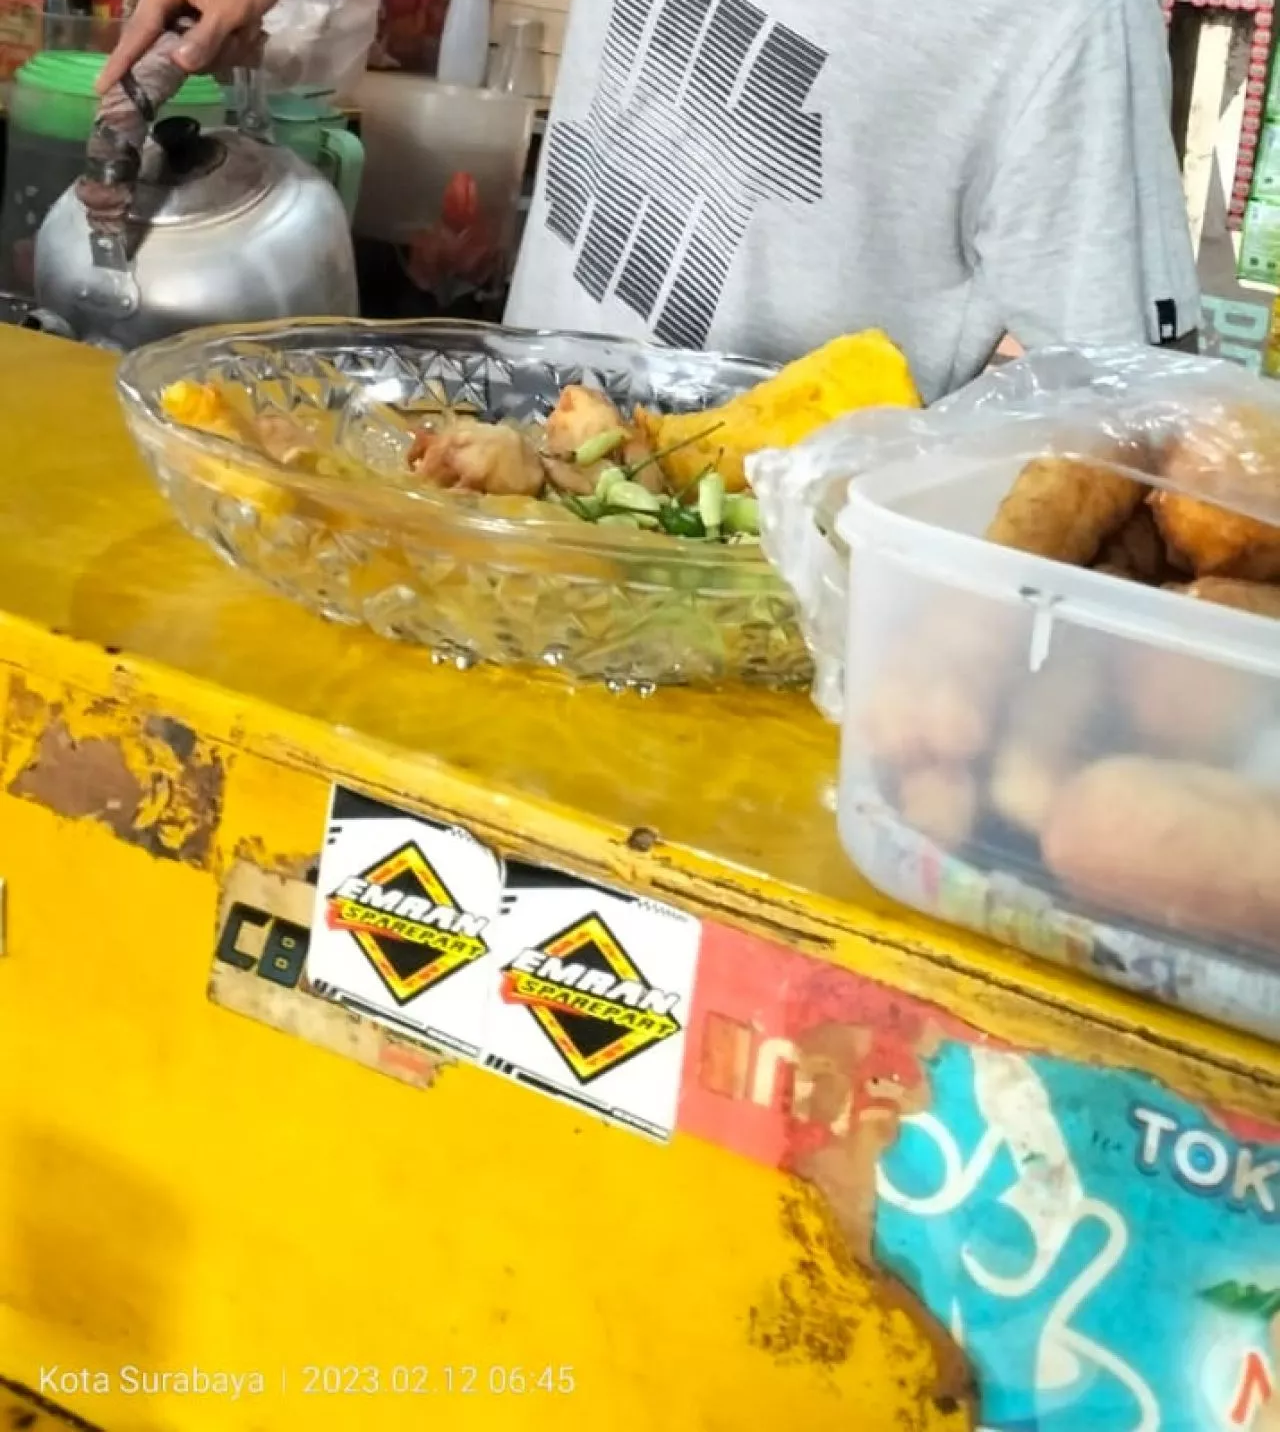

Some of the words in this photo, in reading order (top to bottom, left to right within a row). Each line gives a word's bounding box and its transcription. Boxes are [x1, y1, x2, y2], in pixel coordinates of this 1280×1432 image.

[334, 875, 490, 937] EMRAN
[342, 903, 485, 958] SPAREPART
[511, 947, 681, 1015] EMRAN
[519, 977, 677, 1035] SPAREPART
